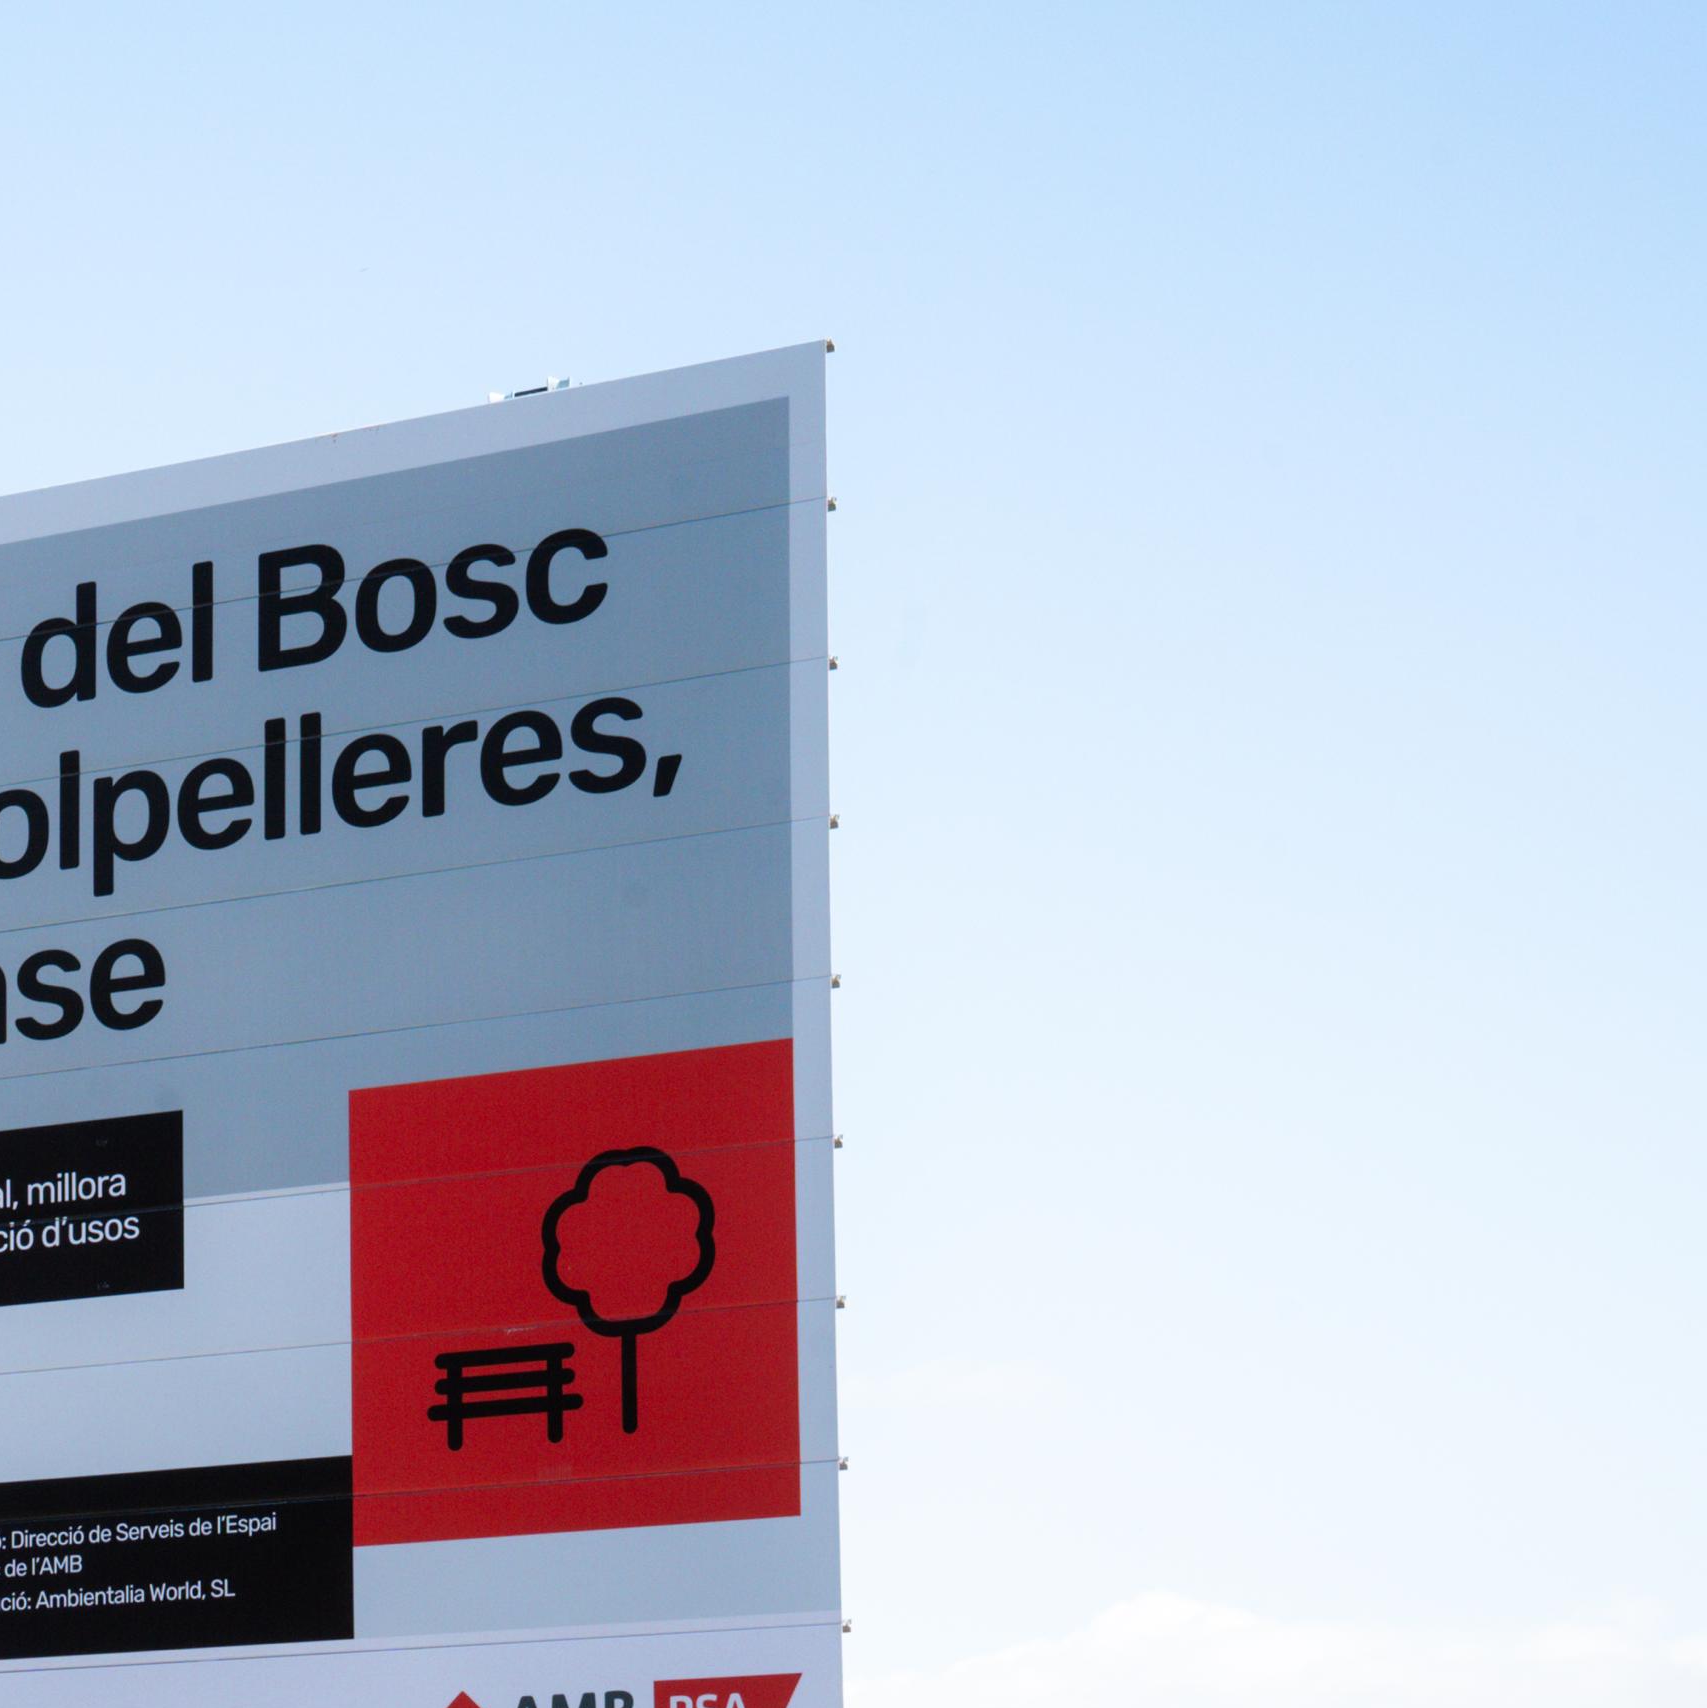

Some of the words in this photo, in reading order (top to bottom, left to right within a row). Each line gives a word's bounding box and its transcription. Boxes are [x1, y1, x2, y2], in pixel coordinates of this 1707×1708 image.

[20, 560, 214, 709] del
[258, 528, 608, 673] Bosc
[26, 1171, 126, 1207] millora
[11, 1524, 84, 1549] Direcció
[88, 1524, 112, 1544] de
[116, 1519, 185, 1542] Serveis
[189, 1516, 212, 1536] de
[4, 1557, 27, 1577] de
[35, 1585, 145, 1610] Ambientalia
[149, 1581, 206, 1602] World,
[211, 1579, 235, 1598] SL
